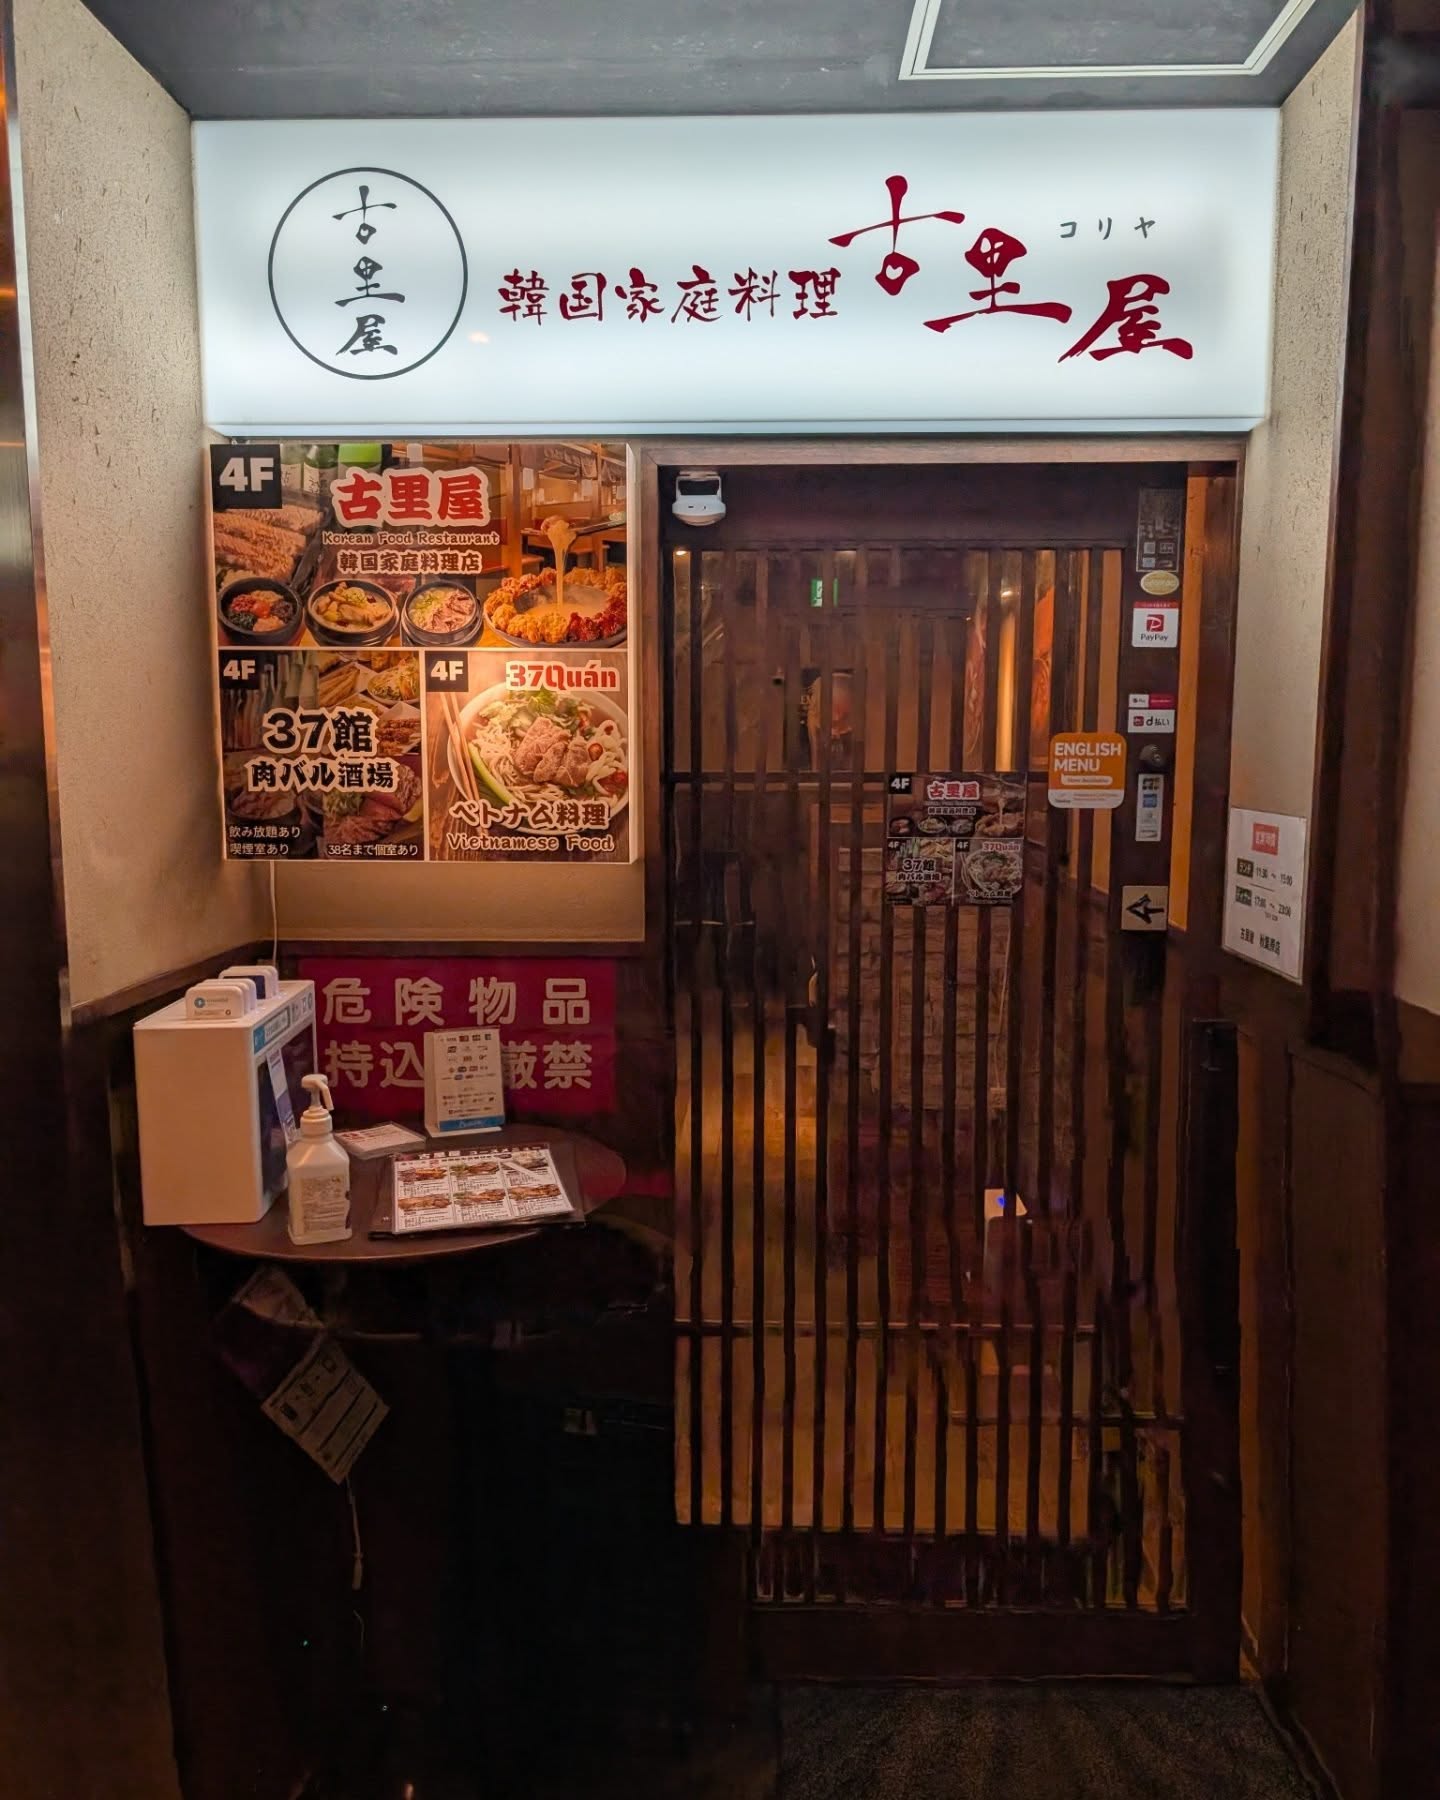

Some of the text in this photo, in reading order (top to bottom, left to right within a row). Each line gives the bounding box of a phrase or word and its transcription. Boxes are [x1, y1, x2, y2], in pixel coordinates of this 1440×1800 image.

[1059, 216, 1156, 240] コリヤ
[332, 185, 406, 357] 古里屋
[497, 175, 1193, 363] 韓国家庭料理 古里屋
[219, 457, 274, 492] 4F
[335, 472, 486, 521] 古里屋
[323, 531, 500, 546] Korean Food Restaurant
[339, 551, 482, 573] 韓国家庭料理店
[1140, 633, 1169, 642] PayPay
[223, 659, 256, 681] 4F
[430, 660, 464, 681] 4F
[509, 663, 617, 691] 37Quán
[266, 711, 374, 753] 37館
[1055, 742, 1122, 756] ENGLISH
[251, 759, 394, 788] 肉バル酒場
[1054, 758, 1101, 772] MENU
[890, 777, 911, 790] 4F
[452, 800, 607, 827] ベトナム料理
[229, 825, 300, 839] 飲み放題あり
[447, 833, 615, 851] Vietnamese Food
[229, 843, 289, 856] 喫煙室あり
[328, 843, 418, 856] 38名まで個室あり
[956, 841, 969, 849] 4F
[321, 976, 591, 1027] 危険物品
